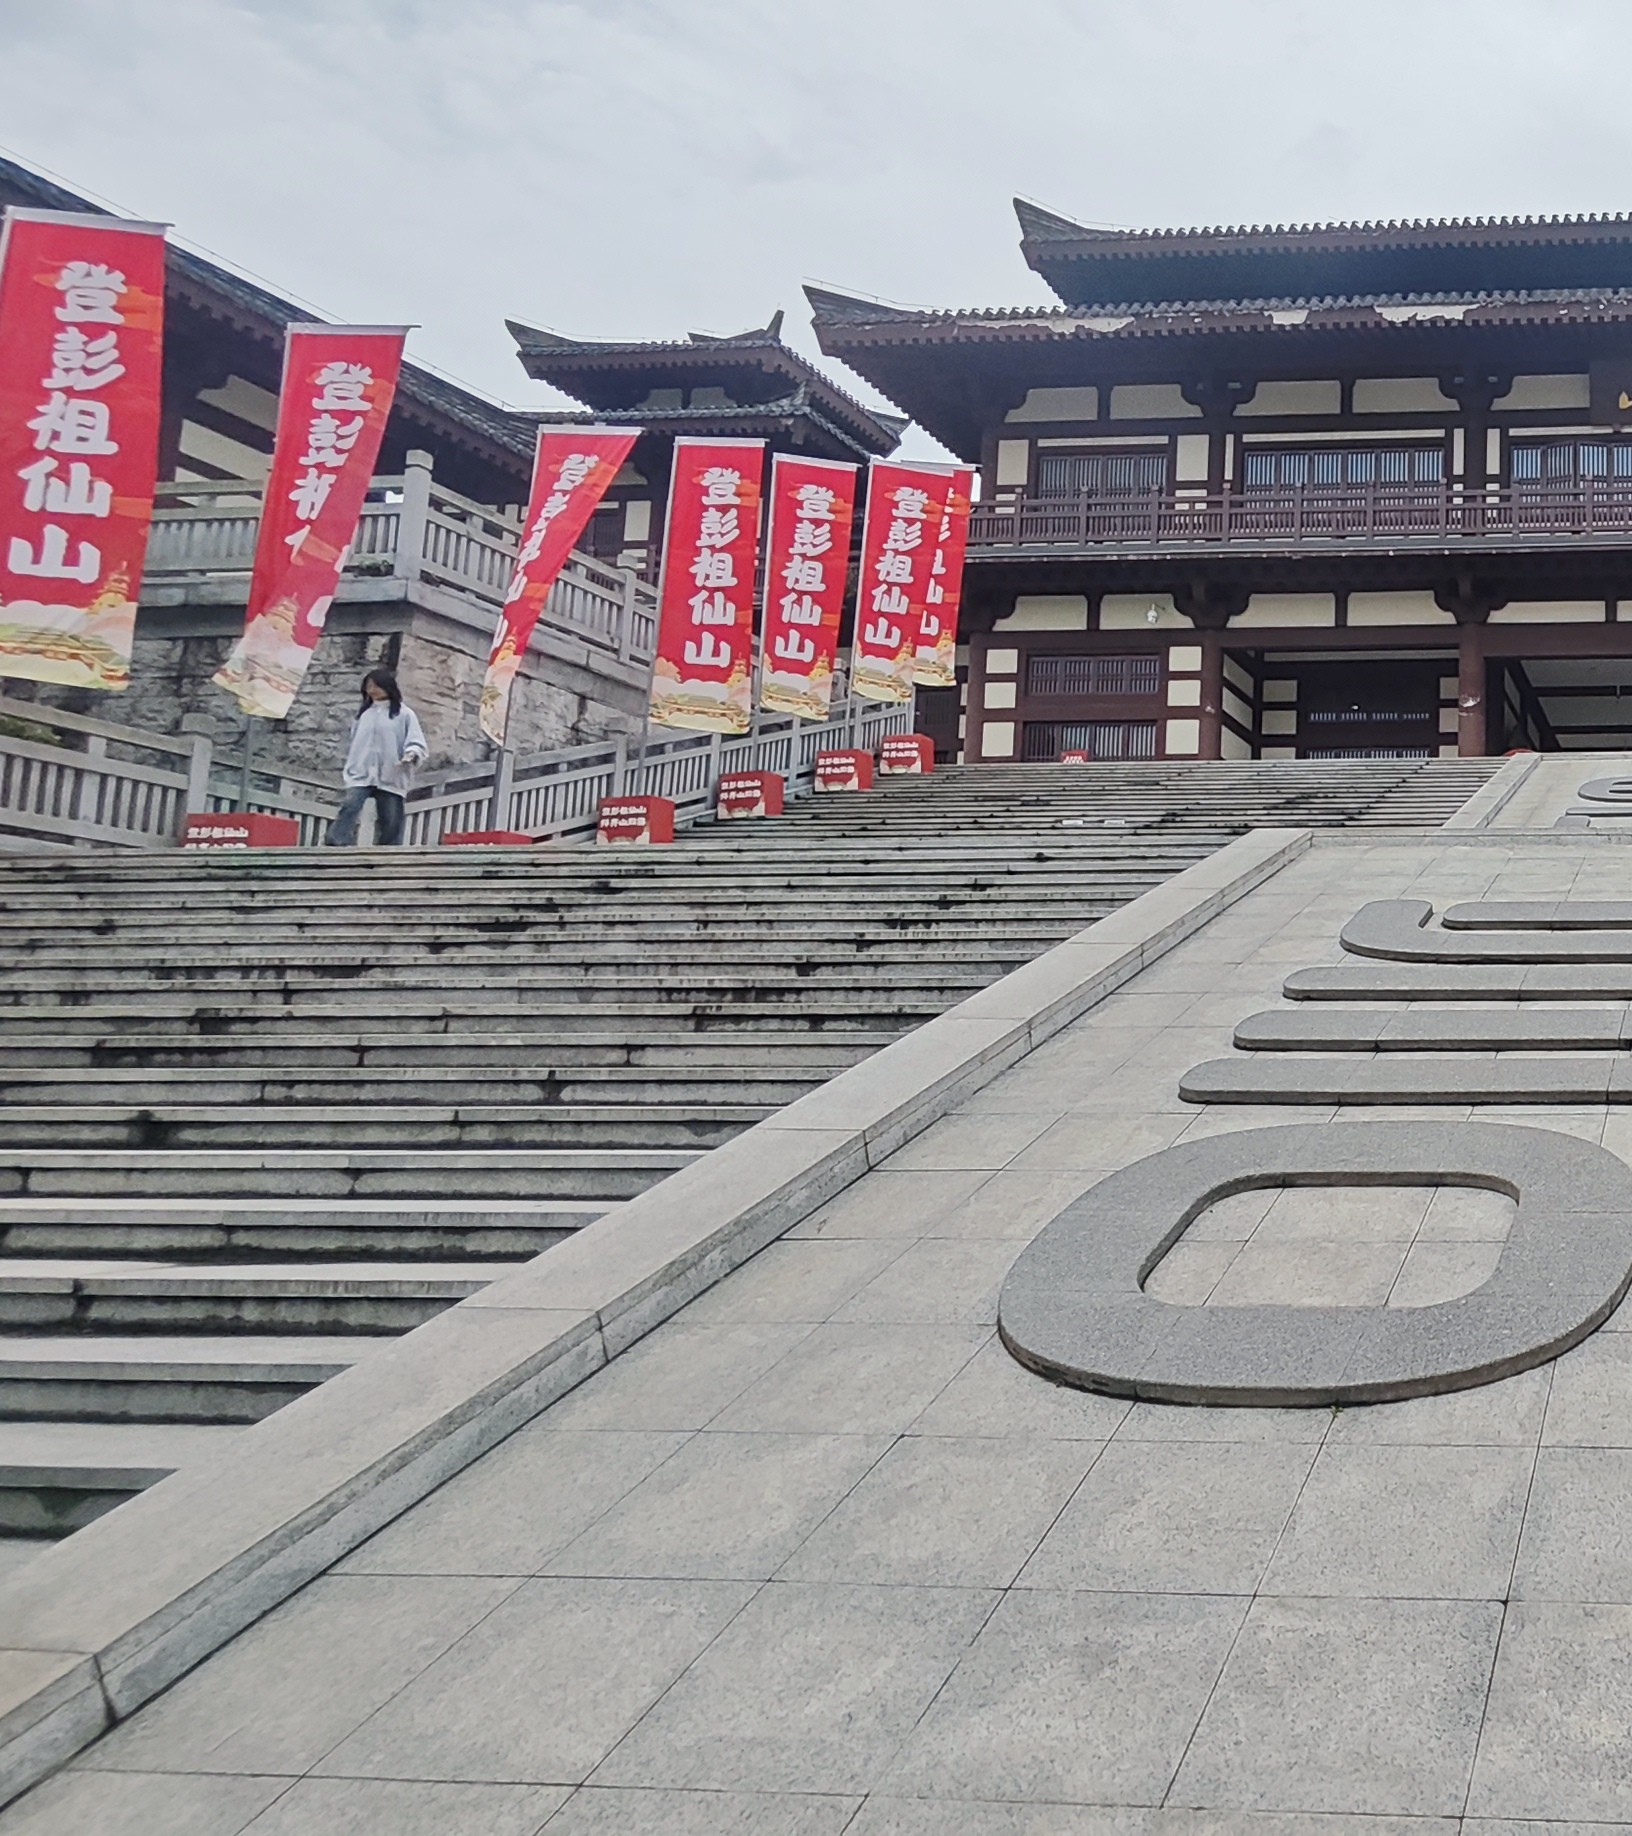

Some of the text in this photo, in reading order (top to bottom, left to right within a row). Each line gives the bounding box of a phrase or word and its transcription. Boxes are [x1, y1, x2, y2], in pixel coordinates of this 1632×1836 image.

[8, 261, 128, 584] 登彭祖仙山
[684, 466, 741, 668] 登彭祖仙山
[774, 484, 836, 663] 登彭祖仙山
[864, 487, 928, 648] 登彭祖仙山
